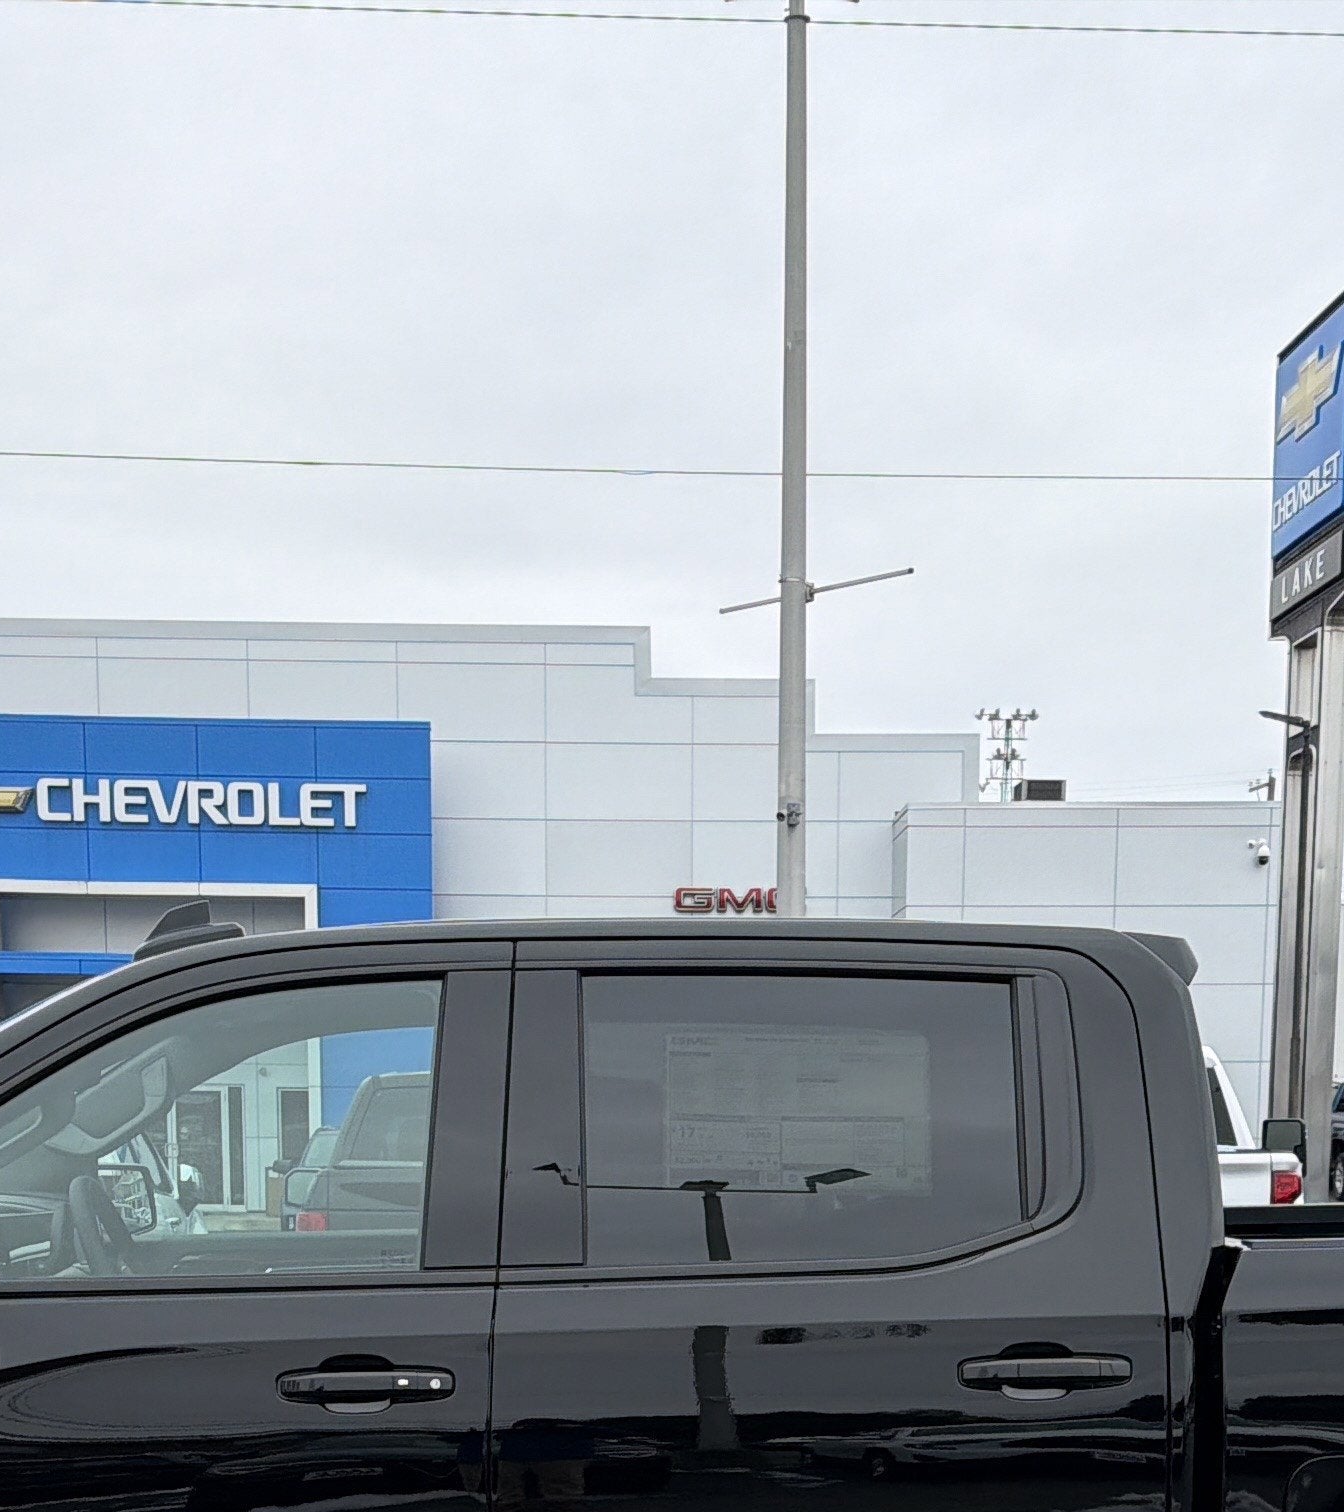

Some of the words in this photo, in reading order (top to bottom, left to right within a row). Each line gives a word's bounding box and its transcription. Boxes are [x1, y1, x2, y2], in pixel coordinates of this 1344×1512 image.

[1272, 450, 1342, 533] CHEVROLET
[1281, 549, 1326, 604] LAKE
[35, 777, 368, 828] CHEVROLET
